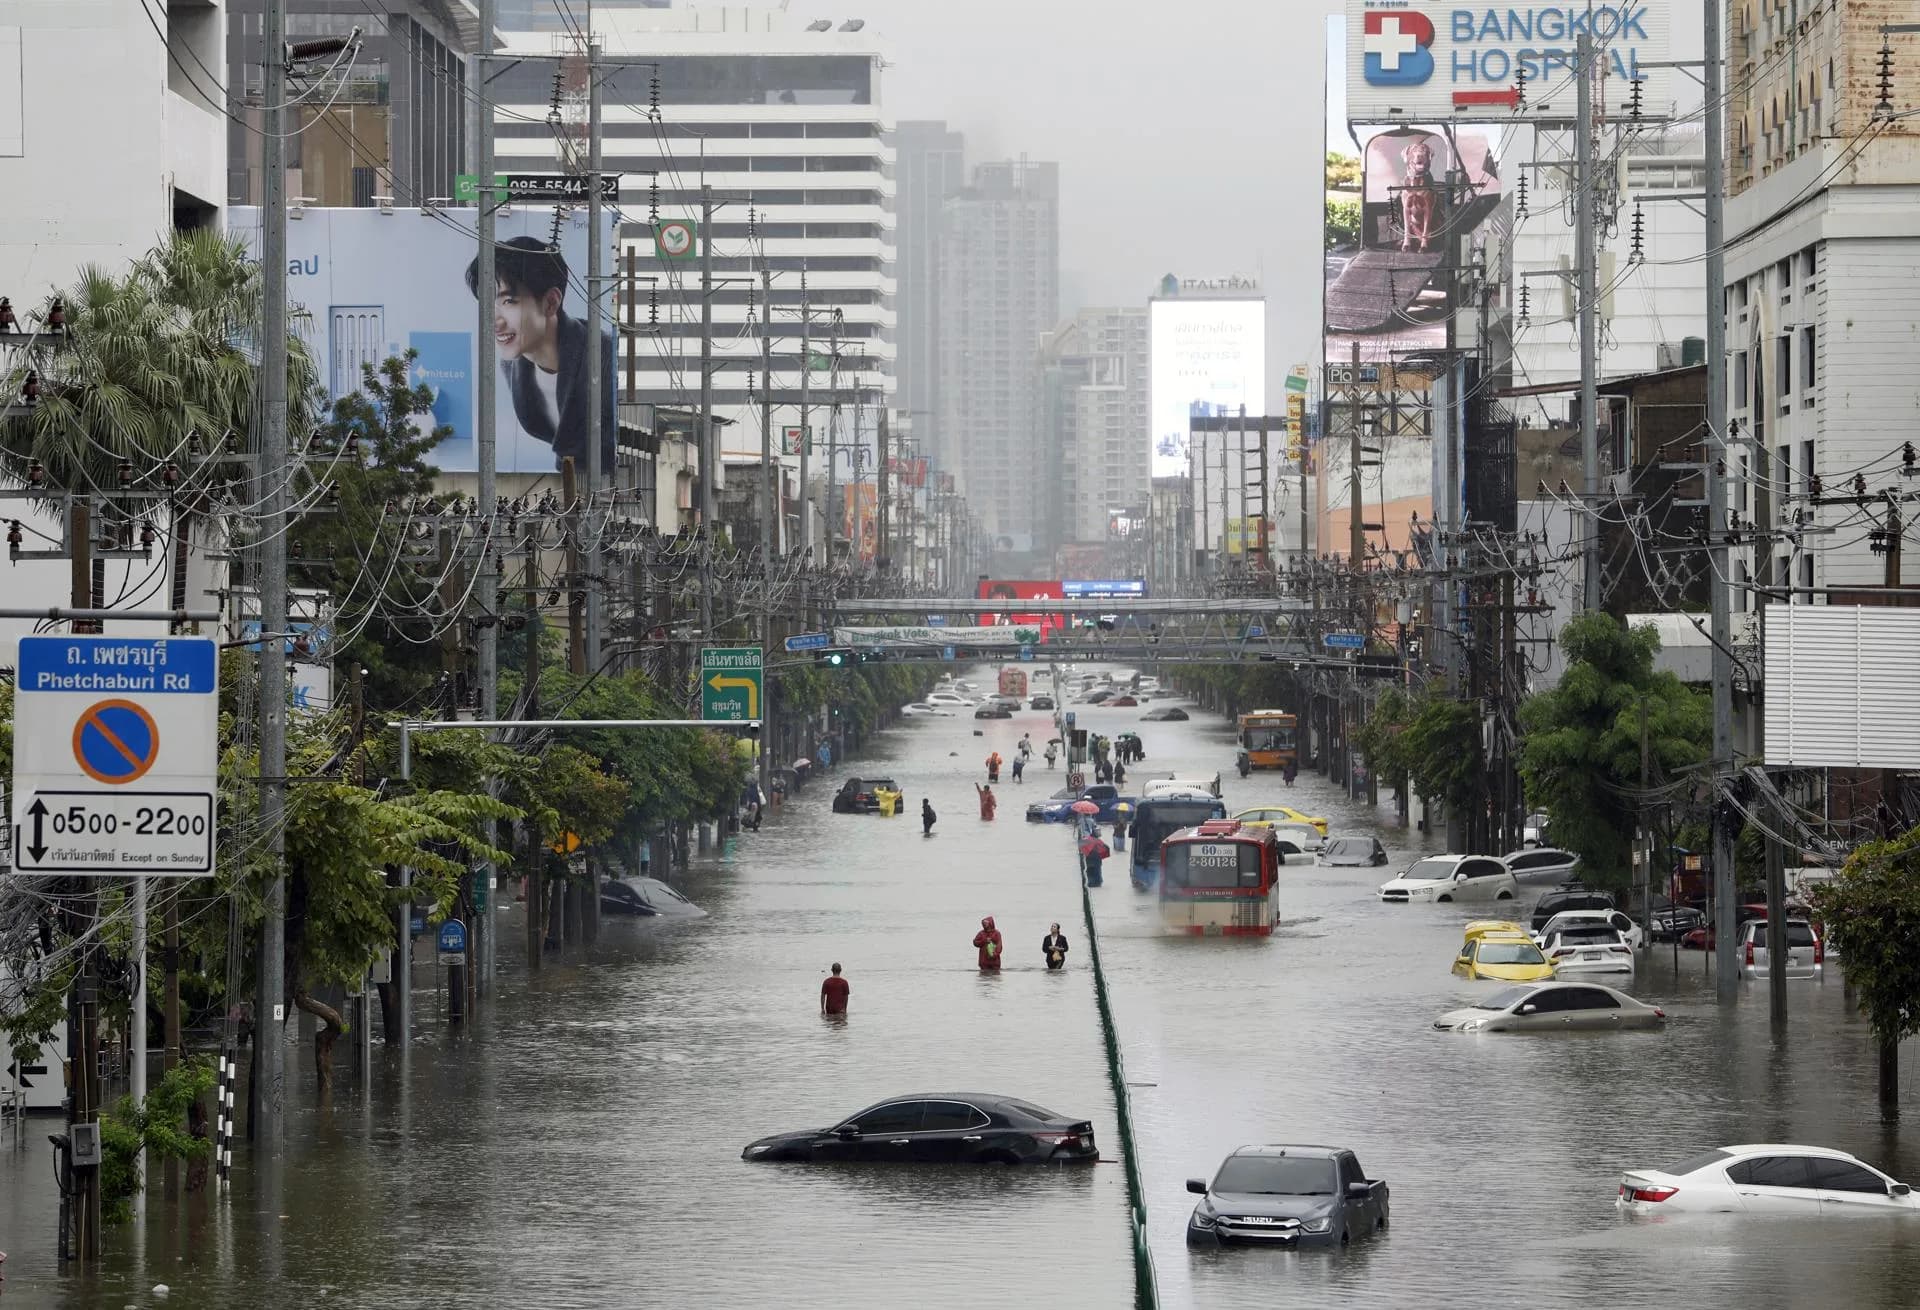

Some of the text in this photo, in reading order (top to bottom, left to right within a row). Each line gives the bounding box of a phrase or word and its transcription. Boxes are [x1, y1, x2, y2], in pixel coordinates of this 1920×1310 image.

[1452, 7, 1648, 42] BANGKOK
[1452, 48, 1648, 82] HOSPIAL
[510, 180, 617, 195] 085-5544-22
[1183, 279, 1256, 289] ITALTHAI
[903, 626, 929, 639] Vote
[66, 640, 167, 672] ถ. เพชรบุรี
[704, 651, 760, 666] เส้นทางลัด
[37, 671, 190, 689] Phetchaburi Rd
[51, 848, 115, 862] เว้นวันอาทิตย์
[1201, 845, 1217, 855] 60
[121, 853, 204, 864] Except on Sunday
[1189, 857, 1237, 867] 2-80126
